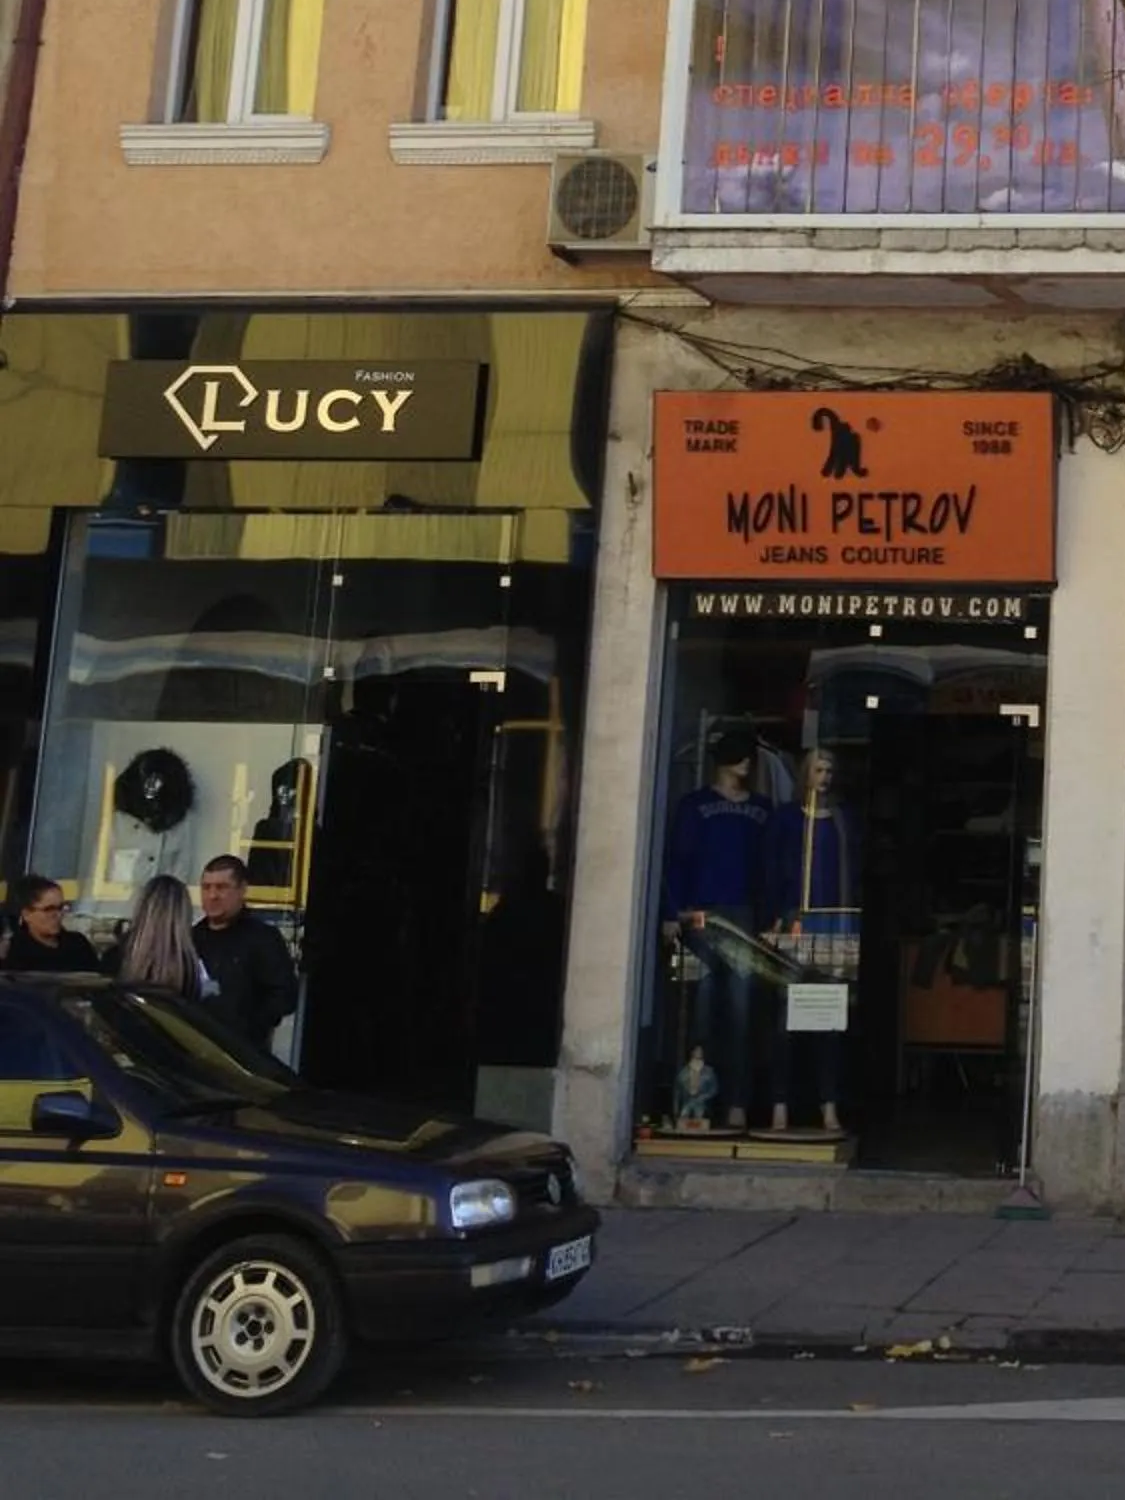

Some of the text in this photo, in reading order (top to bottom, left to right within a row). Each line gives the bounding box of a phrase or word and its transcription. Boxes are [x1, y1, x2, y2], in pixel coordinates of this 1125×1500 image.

[355, 370, 415, 381] FASHION
[201, 381, 413, 432] LUCY
[684, 419, 740, 435] TRADE
[962, 420, 1020, 436] SINCE
[686, 439, 737, 453] MARK
[727, 483, 977, 543] MONI PETROV
[759, 546, 946, 565] JEANS COUTURE
[696, 593, 1022, 618] WWW.MONIPETROV.COM
